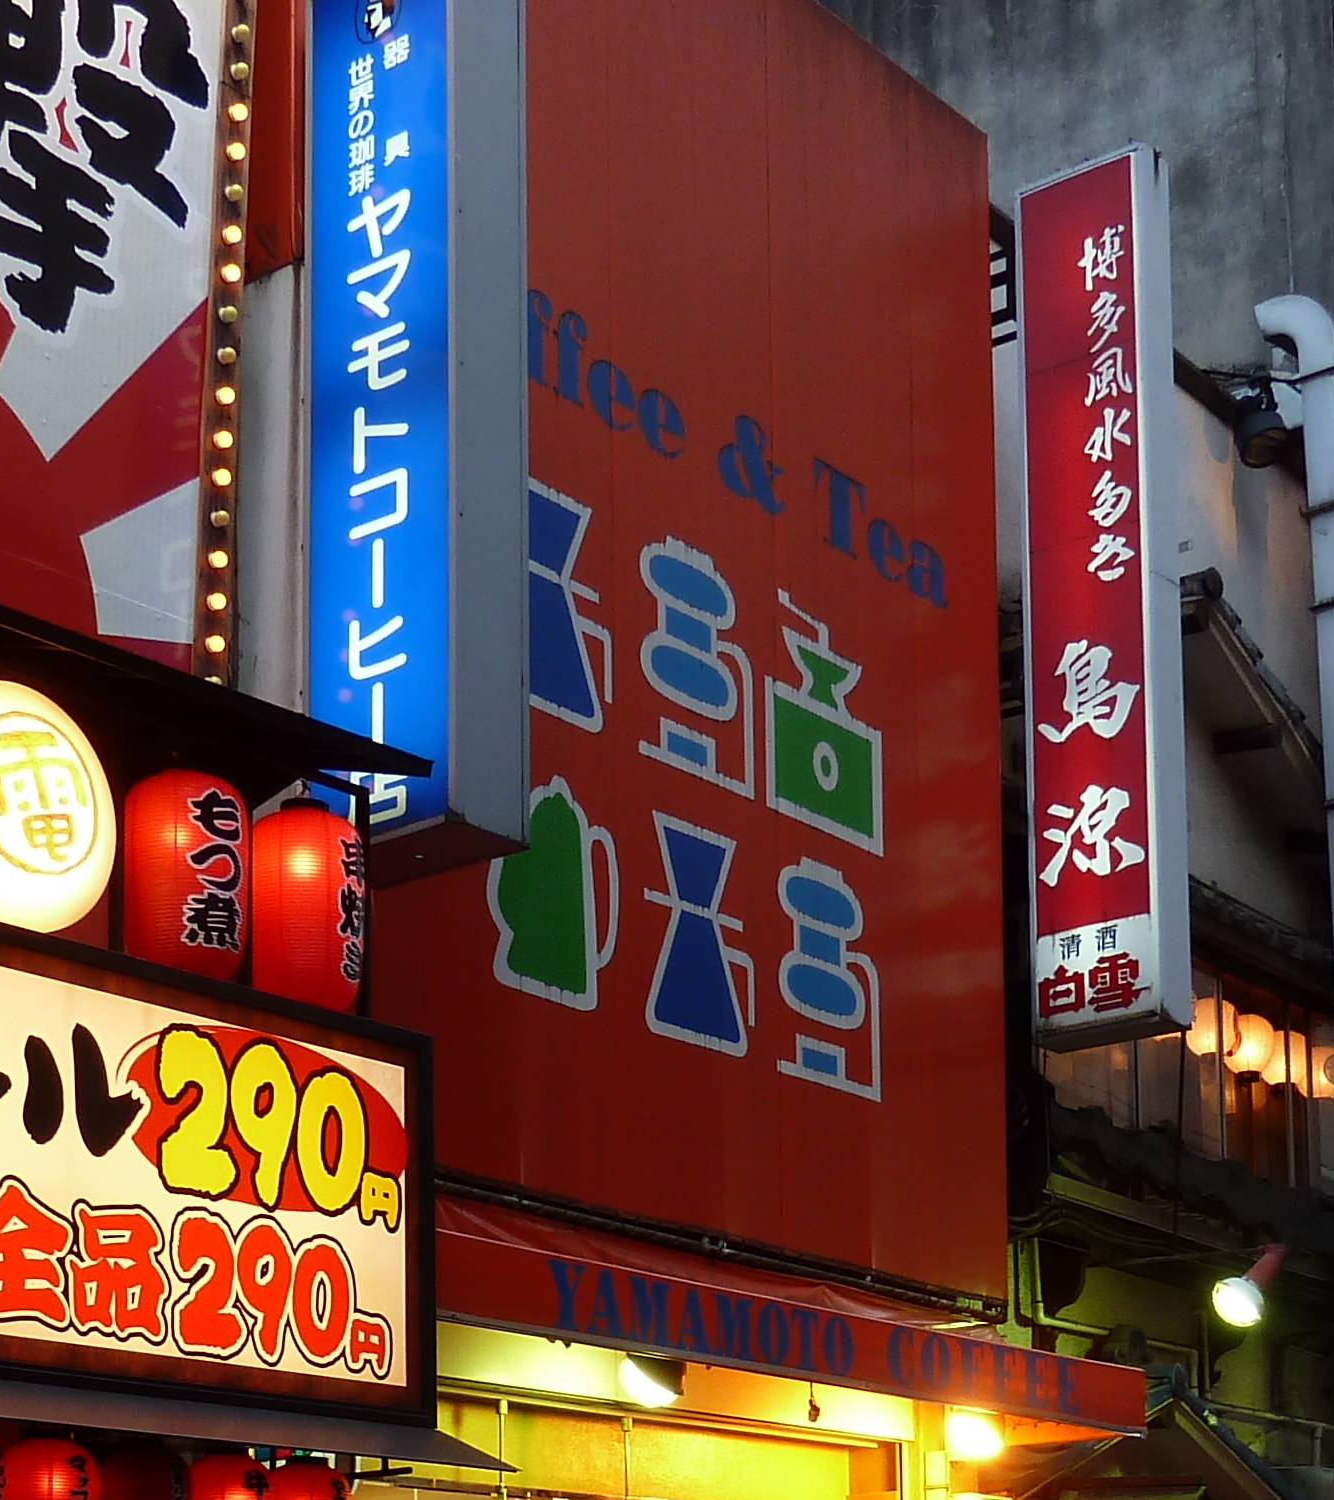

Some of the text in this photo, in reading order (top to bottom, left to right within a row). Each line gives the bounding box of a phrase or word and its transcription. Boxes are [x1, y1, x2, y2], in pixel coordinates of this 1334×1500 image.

[348, 55, 375, 197] 世界の珈琲
[718, 415, 785, 515] &
[814, 456, 947, 609] Tea
[185, 790, 240, 951] もつ煮
[1059, 924, 1118, 959] 清酒
[1037, 951, 1151, 1018] 白雪
[156, 1023, 401, 1230] 290円
[546, 1258, 1081, 1415] YAMAMOTO COFFEE
